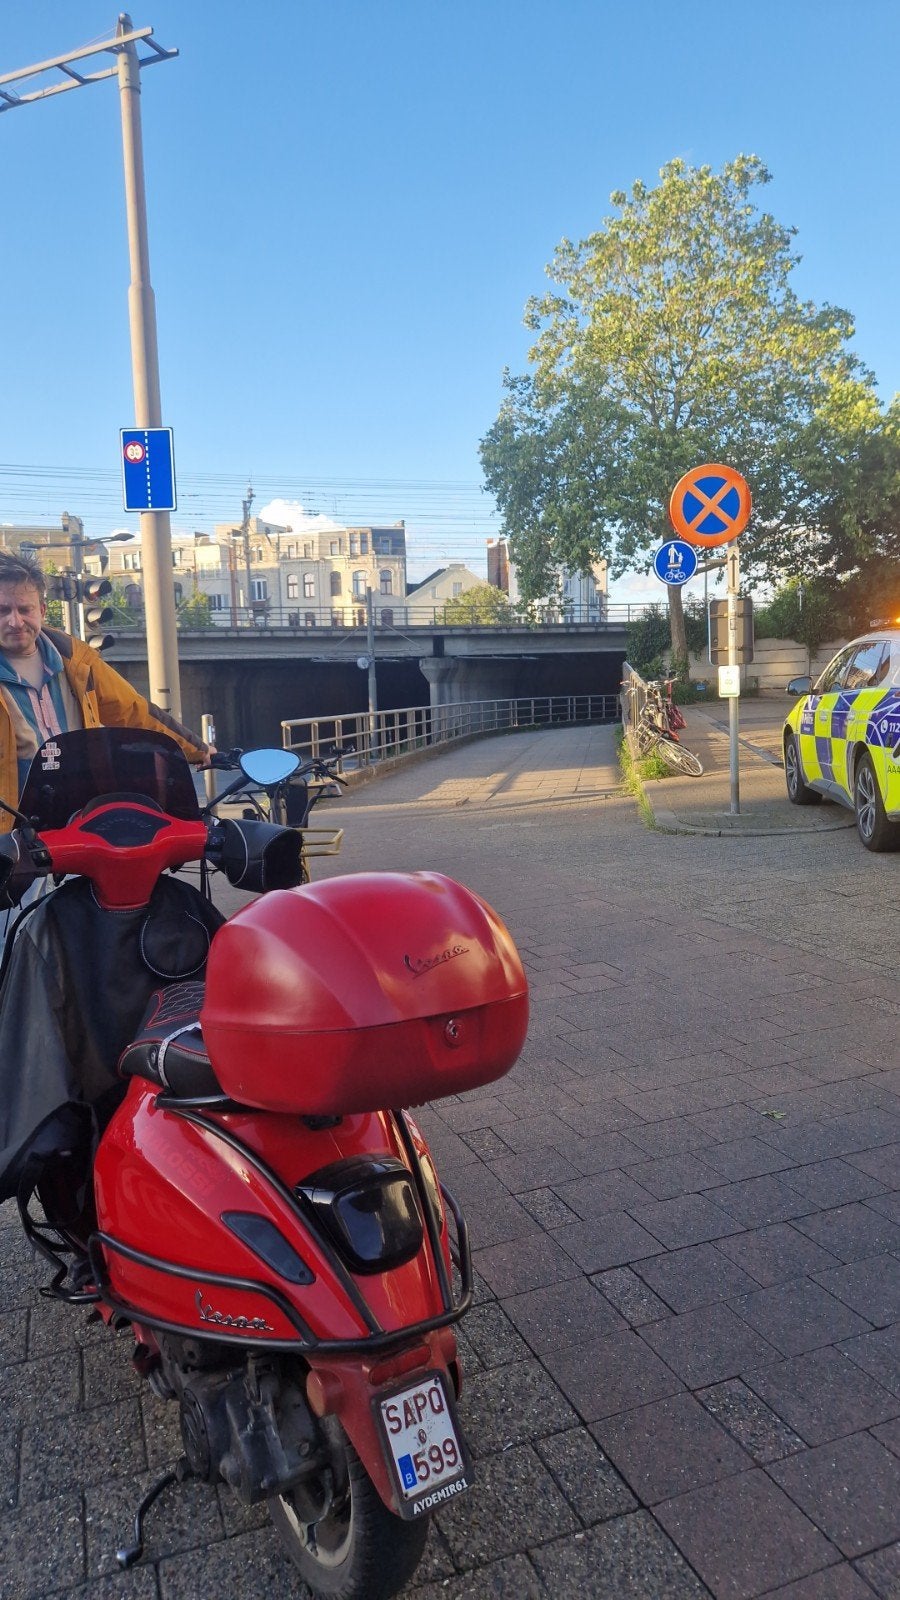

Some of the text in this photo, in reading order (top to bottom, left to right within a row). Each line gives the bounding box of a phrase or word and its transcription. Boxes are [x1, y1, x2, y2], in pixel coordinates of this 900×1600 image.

[889, 722, 900, 733] 112
[404, 945, 470, 979] Vespa
[194, 1288, 274, 1331] Vespa
[385, 1386, 444, 1434] SAPQ
[413, 1438, 458, 1482] 599
[406, 1474, 413, 1484] B
[413, 1478, 468, 1515] AYDEMIR61
